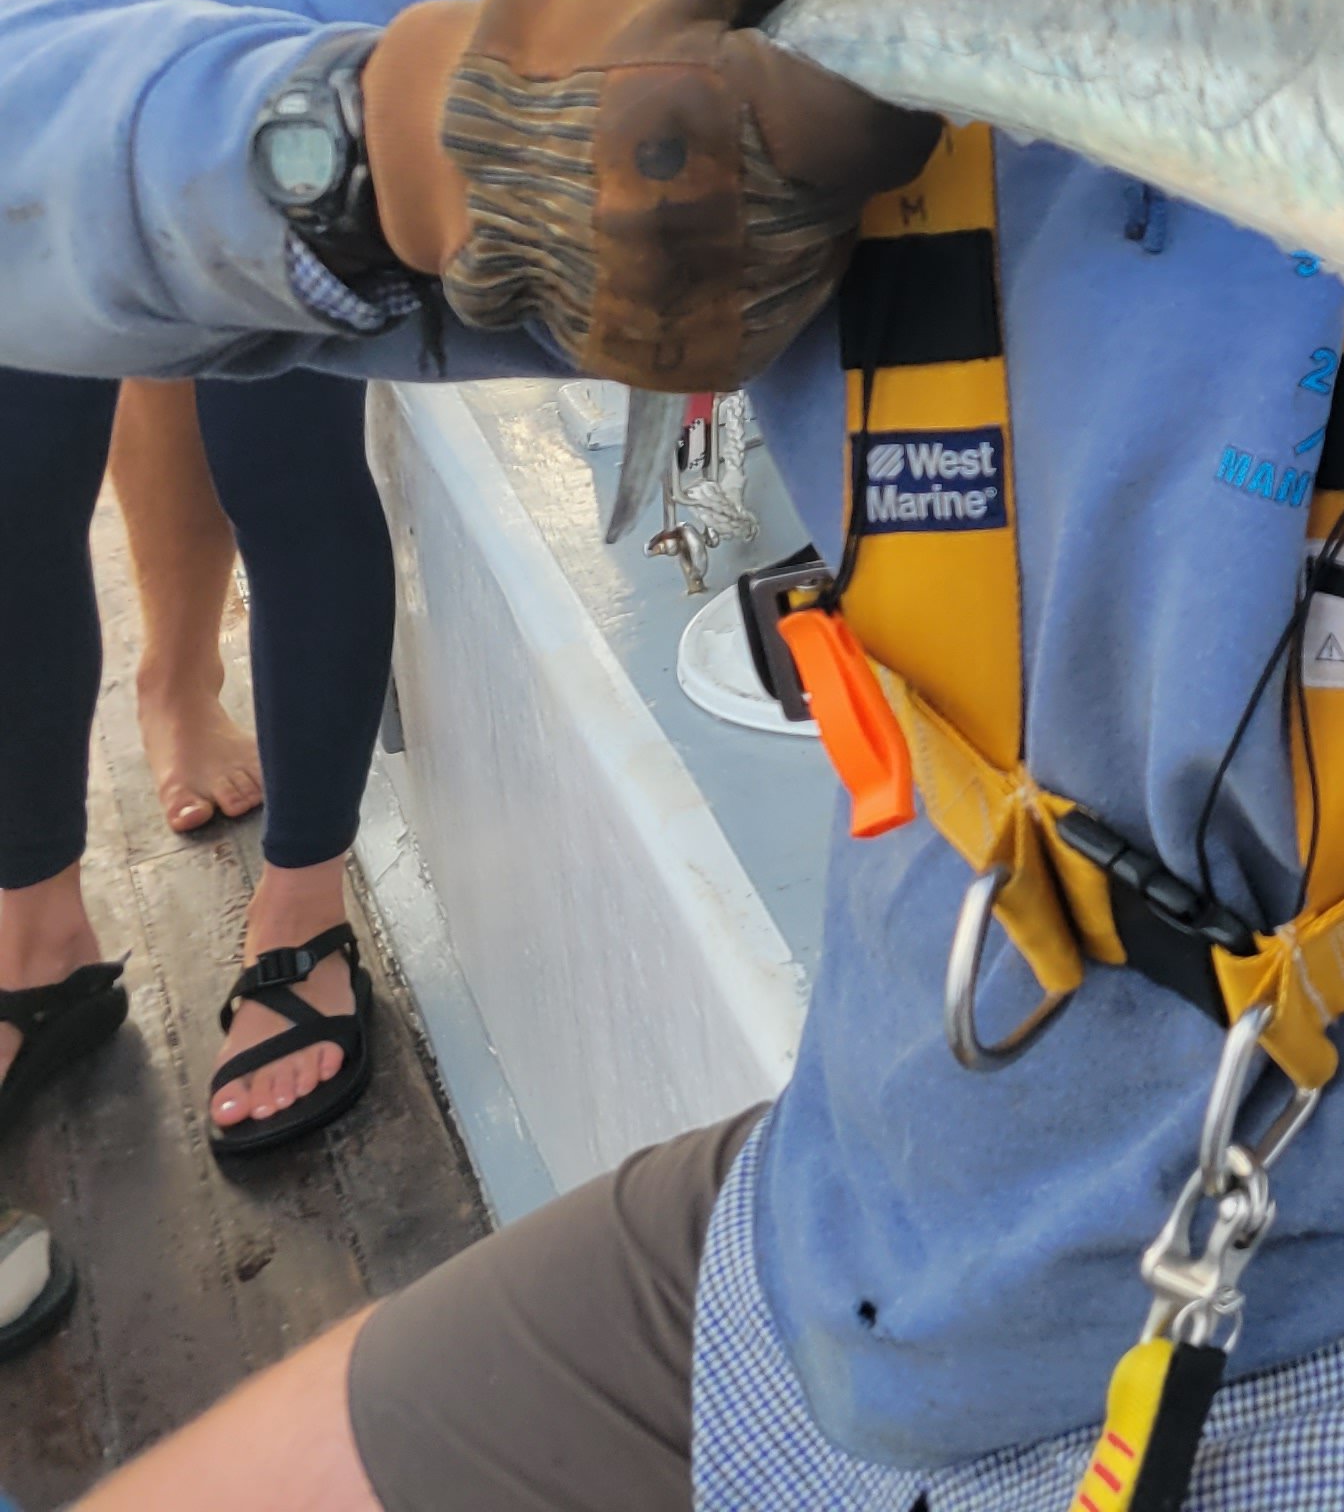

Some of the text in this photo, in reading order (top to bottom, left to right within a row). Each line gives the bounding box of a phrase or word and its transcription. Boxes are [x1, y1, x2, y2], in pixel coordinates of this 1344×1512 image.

[1299, 347, 1338, 395] 2
[906, 441, 997, 480] West
[866, 483, 988, 523] Marine
